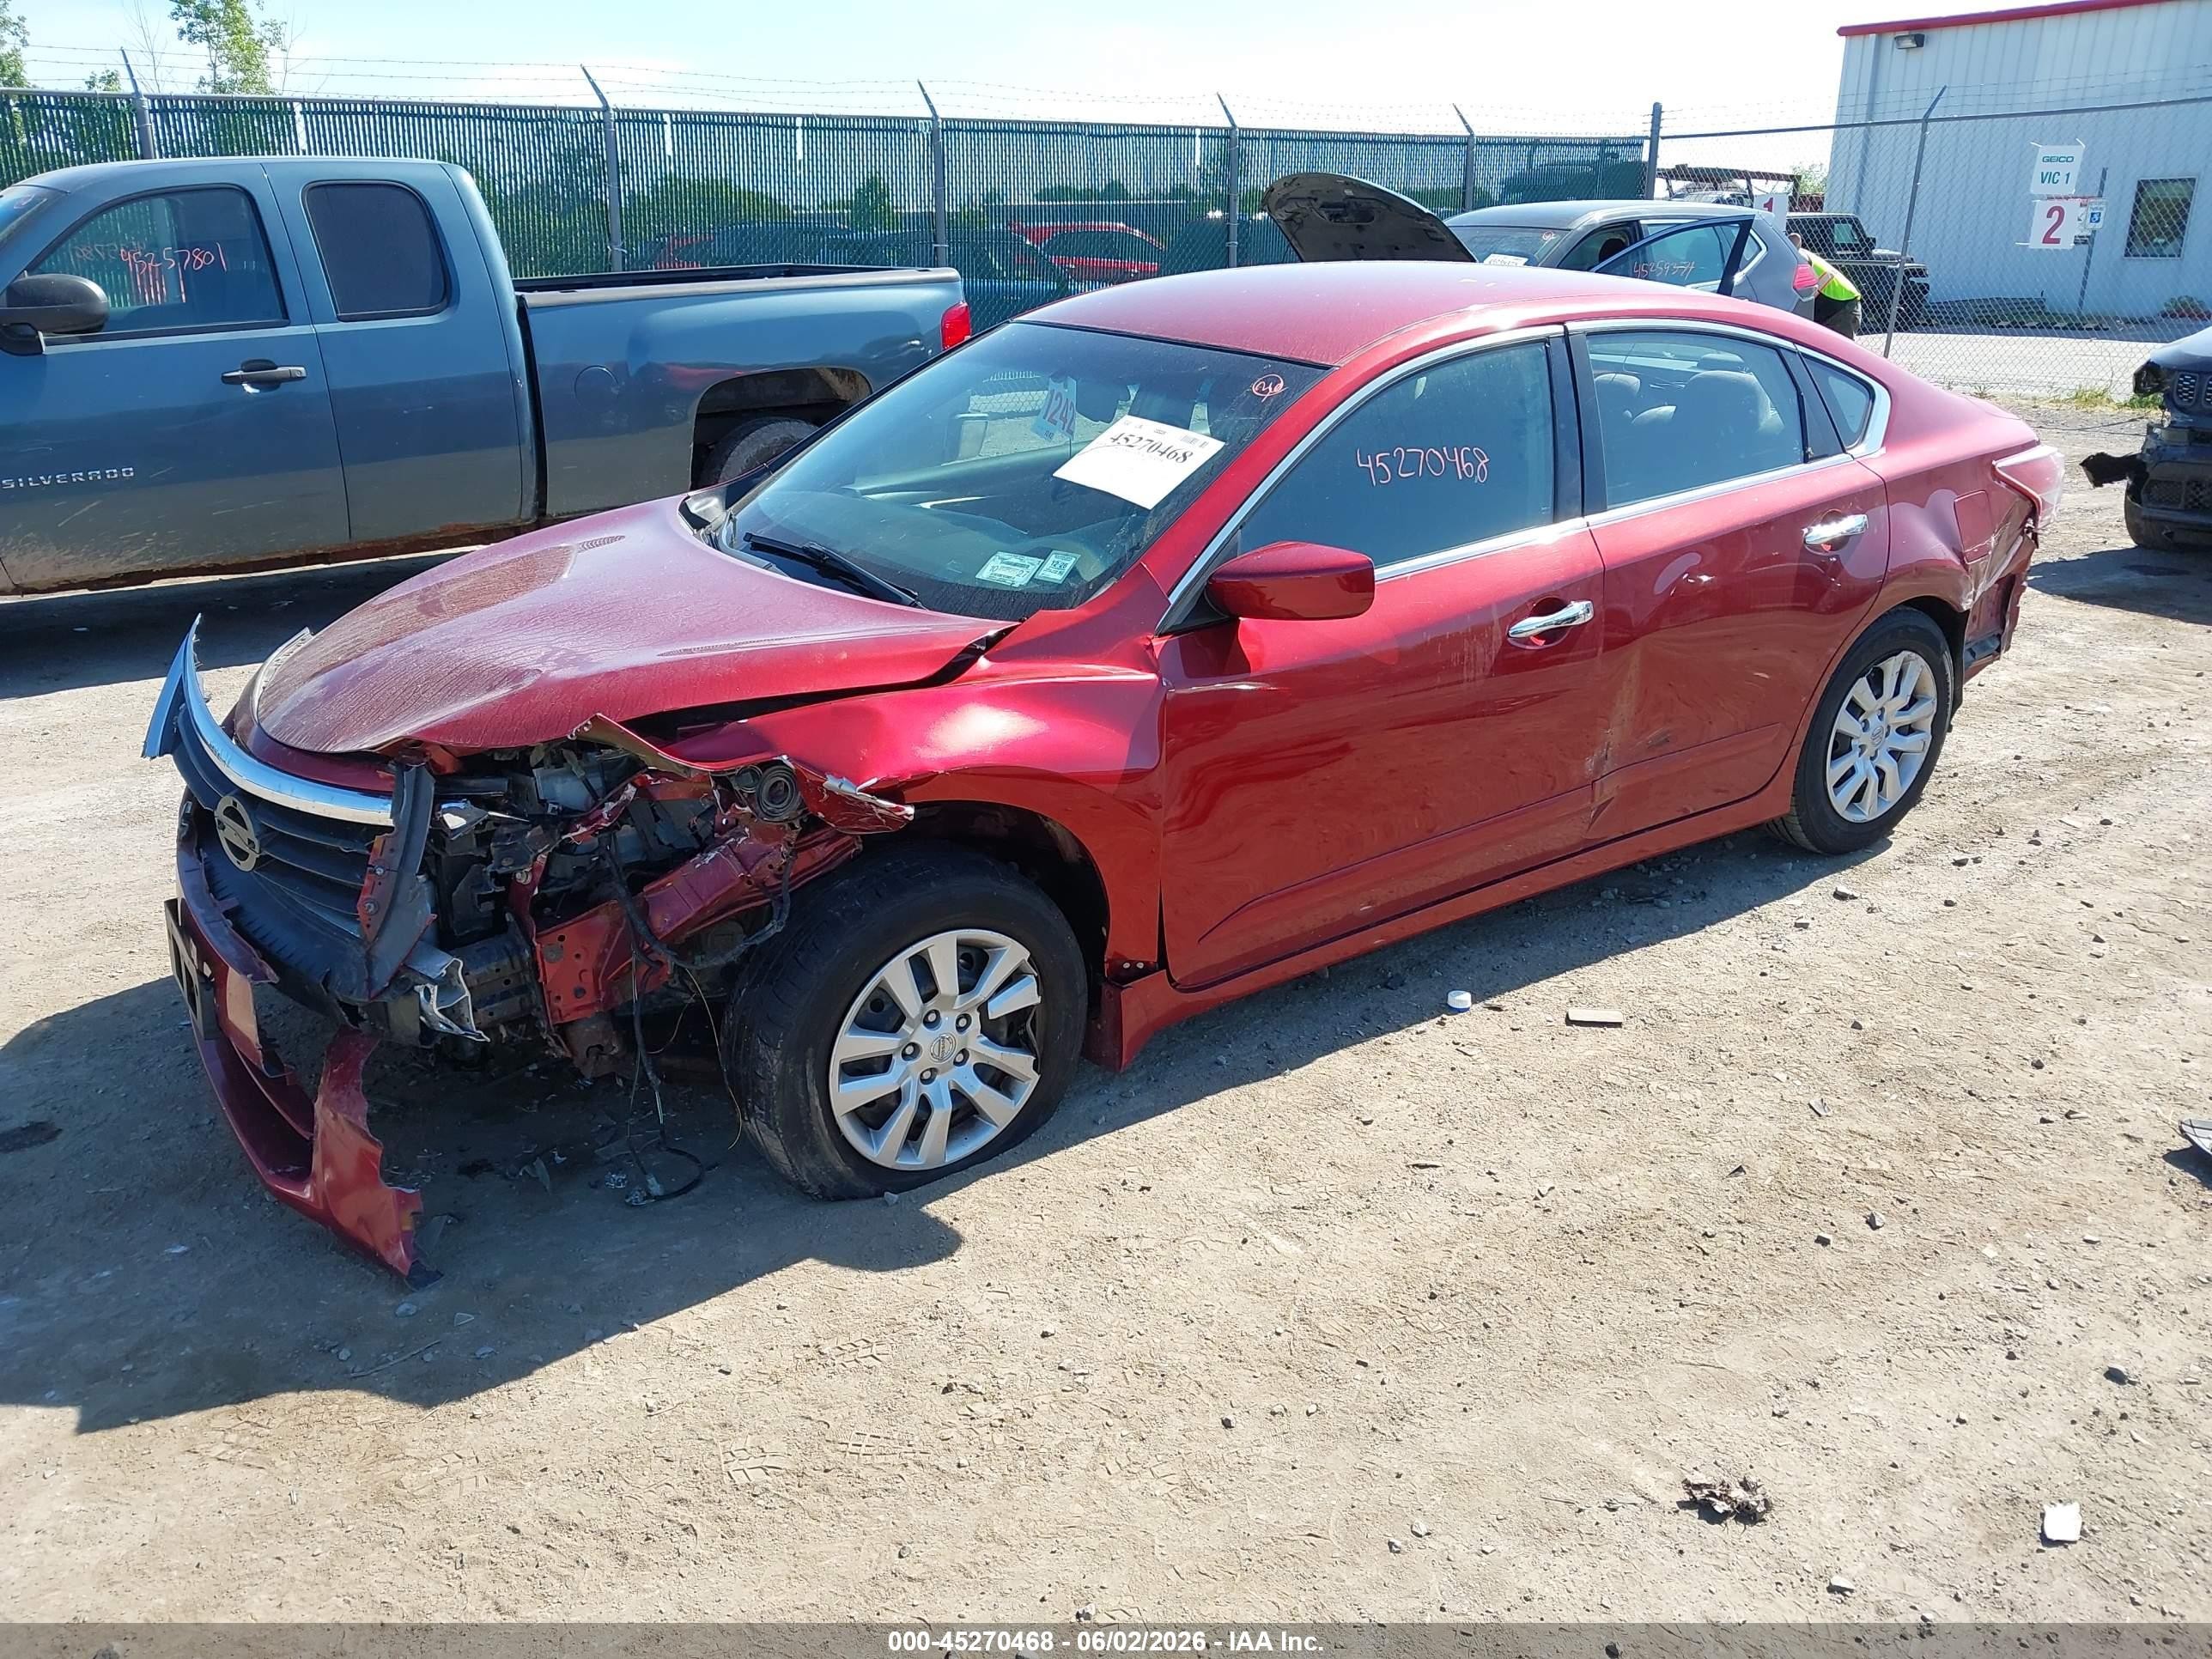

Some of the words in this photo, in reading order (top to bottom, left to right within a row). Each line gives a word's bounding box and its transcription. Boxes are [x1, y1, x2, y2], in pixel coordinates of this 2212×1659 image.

[2040, 171, 2060, 185] VIC
[2065, 172, 2071, 185] 1
[2041, 205, 2065, 245] 2
[120, 242, 227, 273] 45257801
[1109, 432, 1194, 464] 45270468
[2, 466, 135, 489] SILVERADO
[1356, 446, 1490, 487] 45270468
